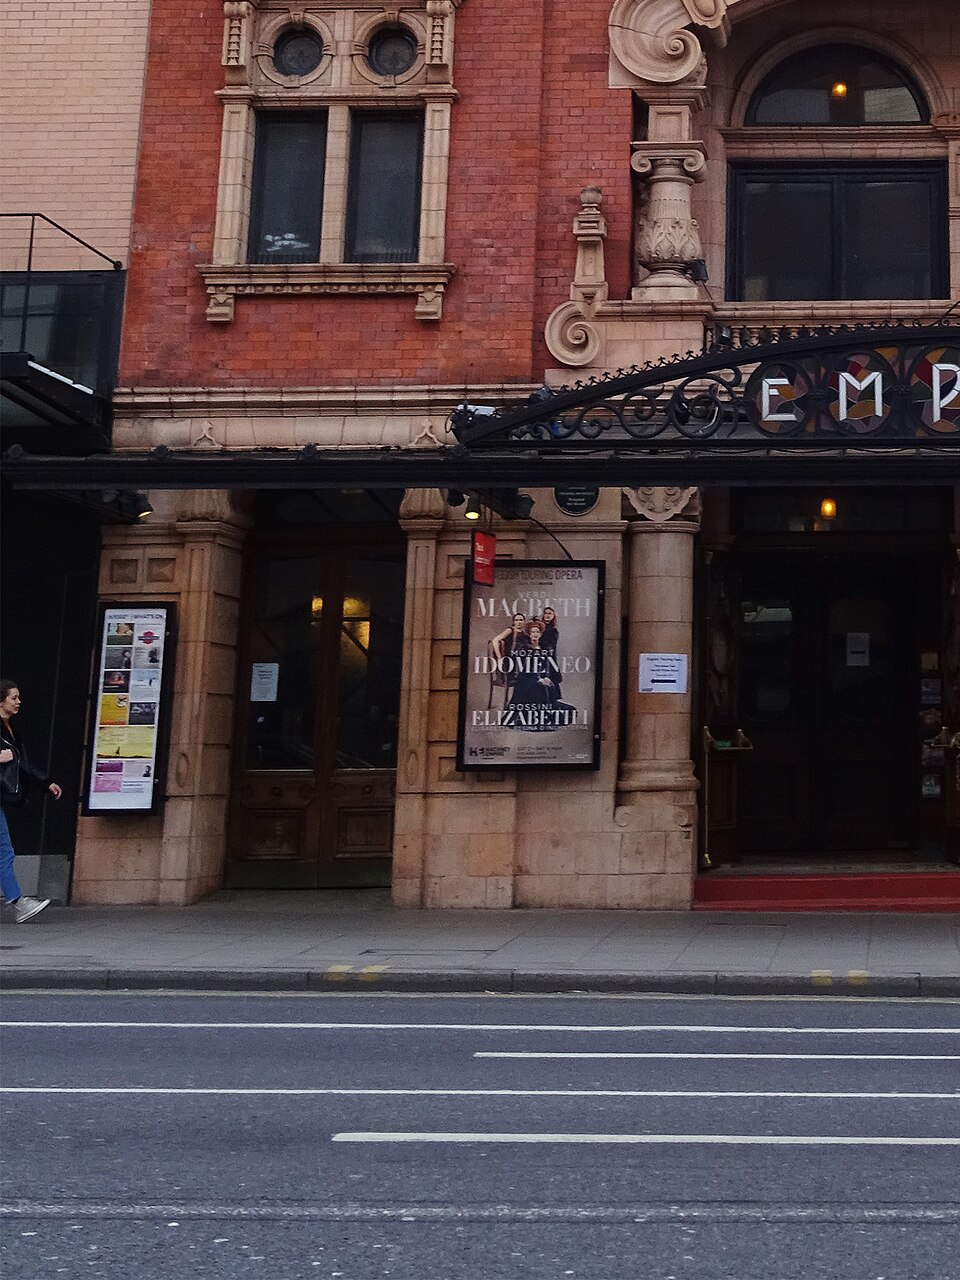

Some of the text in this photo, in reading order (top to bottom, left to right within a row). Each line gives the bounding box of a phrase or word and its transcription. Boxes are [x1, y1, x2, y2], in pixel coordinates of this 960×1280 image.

[555, 569, 582, 580] OPERA
[510, 649, 555, 658] MOZART
[473, 656, 591, 674] IDOMENEO
[509, 703, 553, 711] ROSSINI
[472, 710, 578, 726] ELIZABETH
